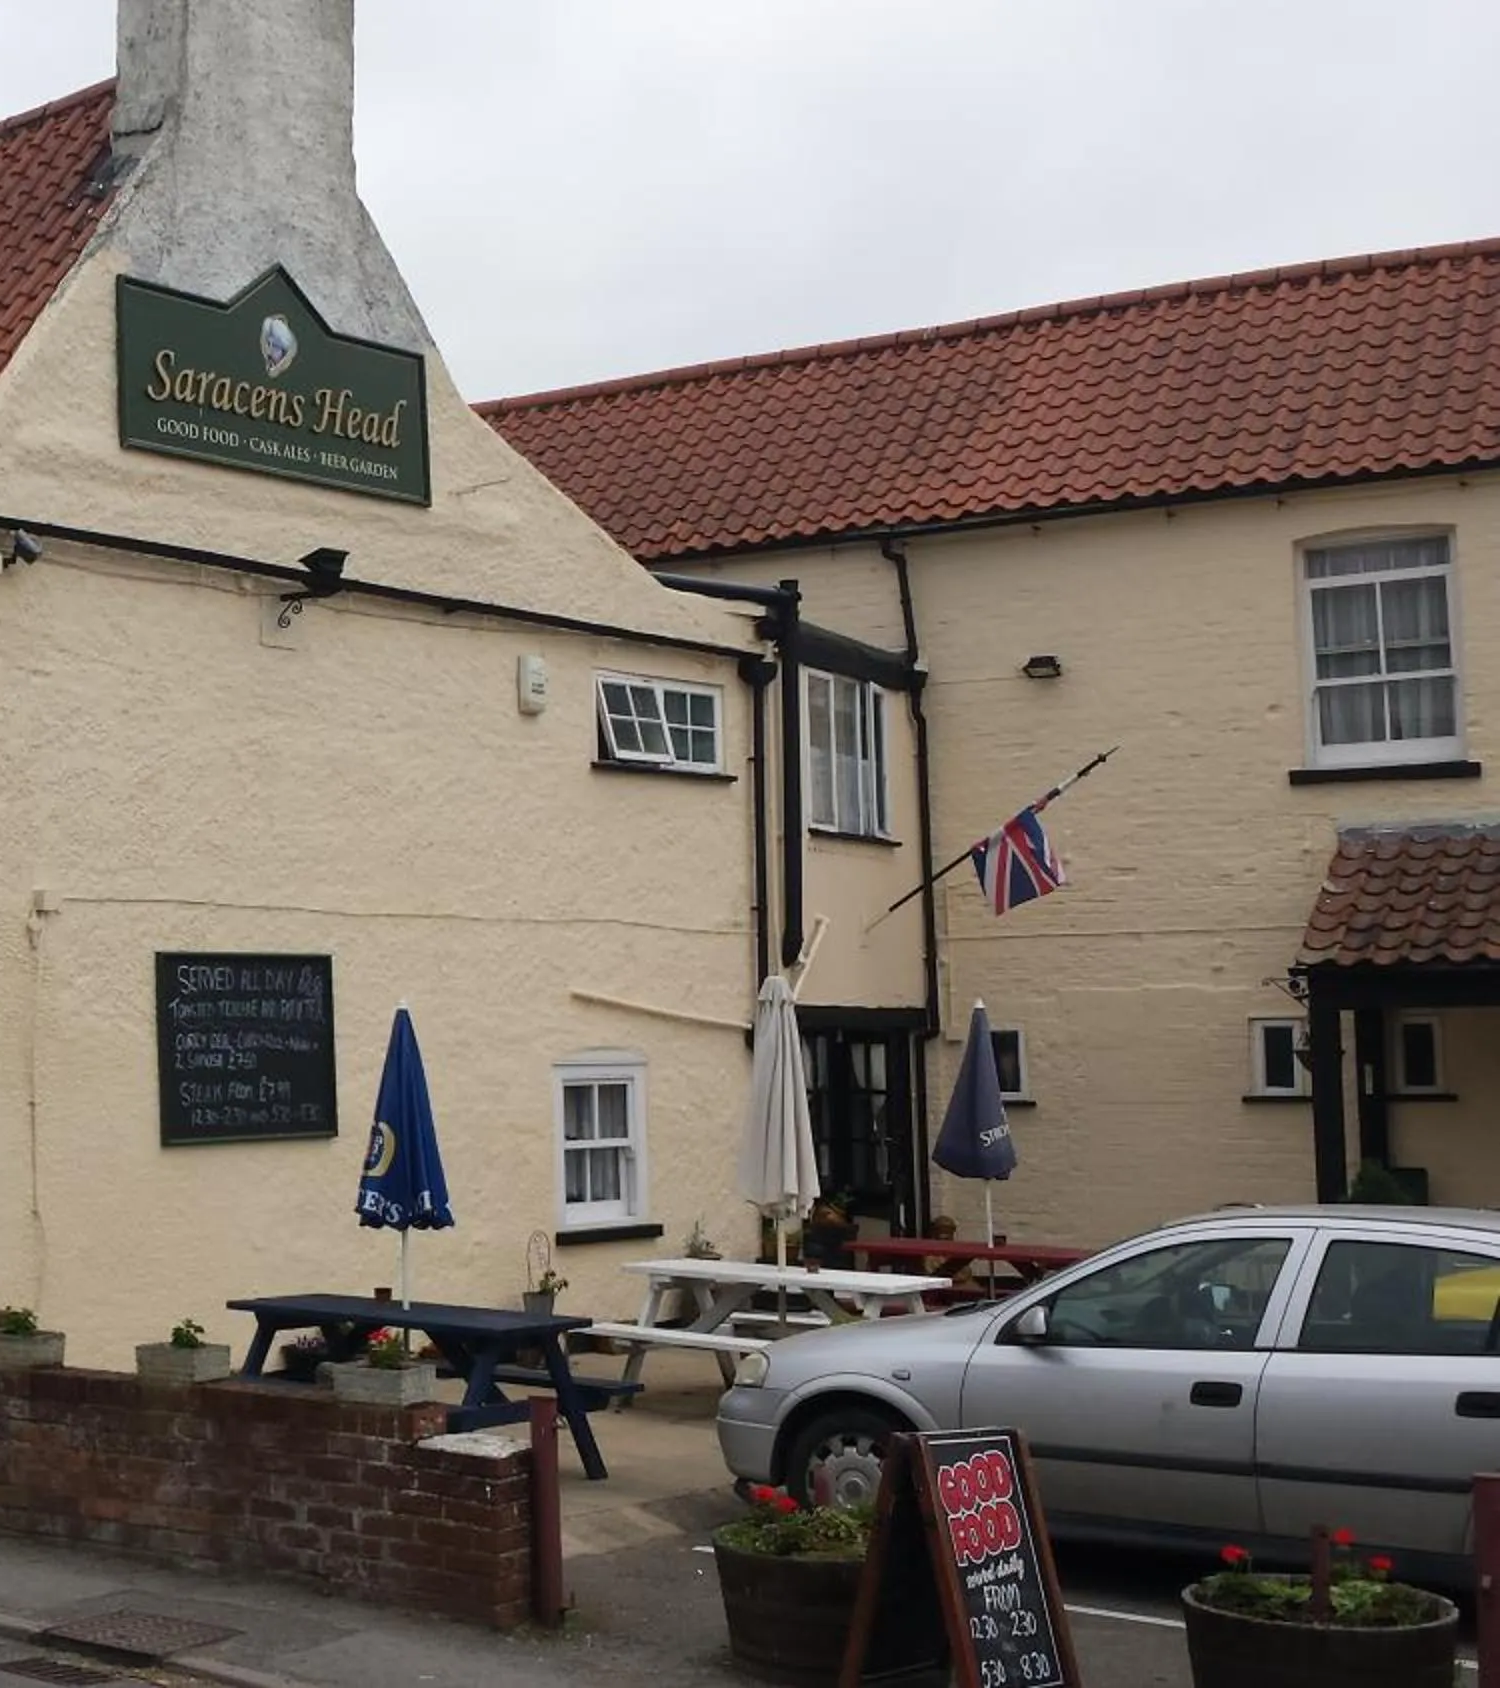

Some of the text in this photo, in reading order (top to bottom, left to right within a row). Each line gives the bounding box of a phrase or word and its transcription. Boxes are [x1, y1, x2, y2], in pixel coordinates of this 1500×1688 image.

[148, 349, 407, 448] Saracens Head
[157, 417, 399, 480] GOOD FOOD CASK ALES BEER GARDEN
[937, 1450, 1014, 1517] GOOD
[948, 1499, 1022, 1567] FOOD
[983, 1583, 1021, 1613] FROM
